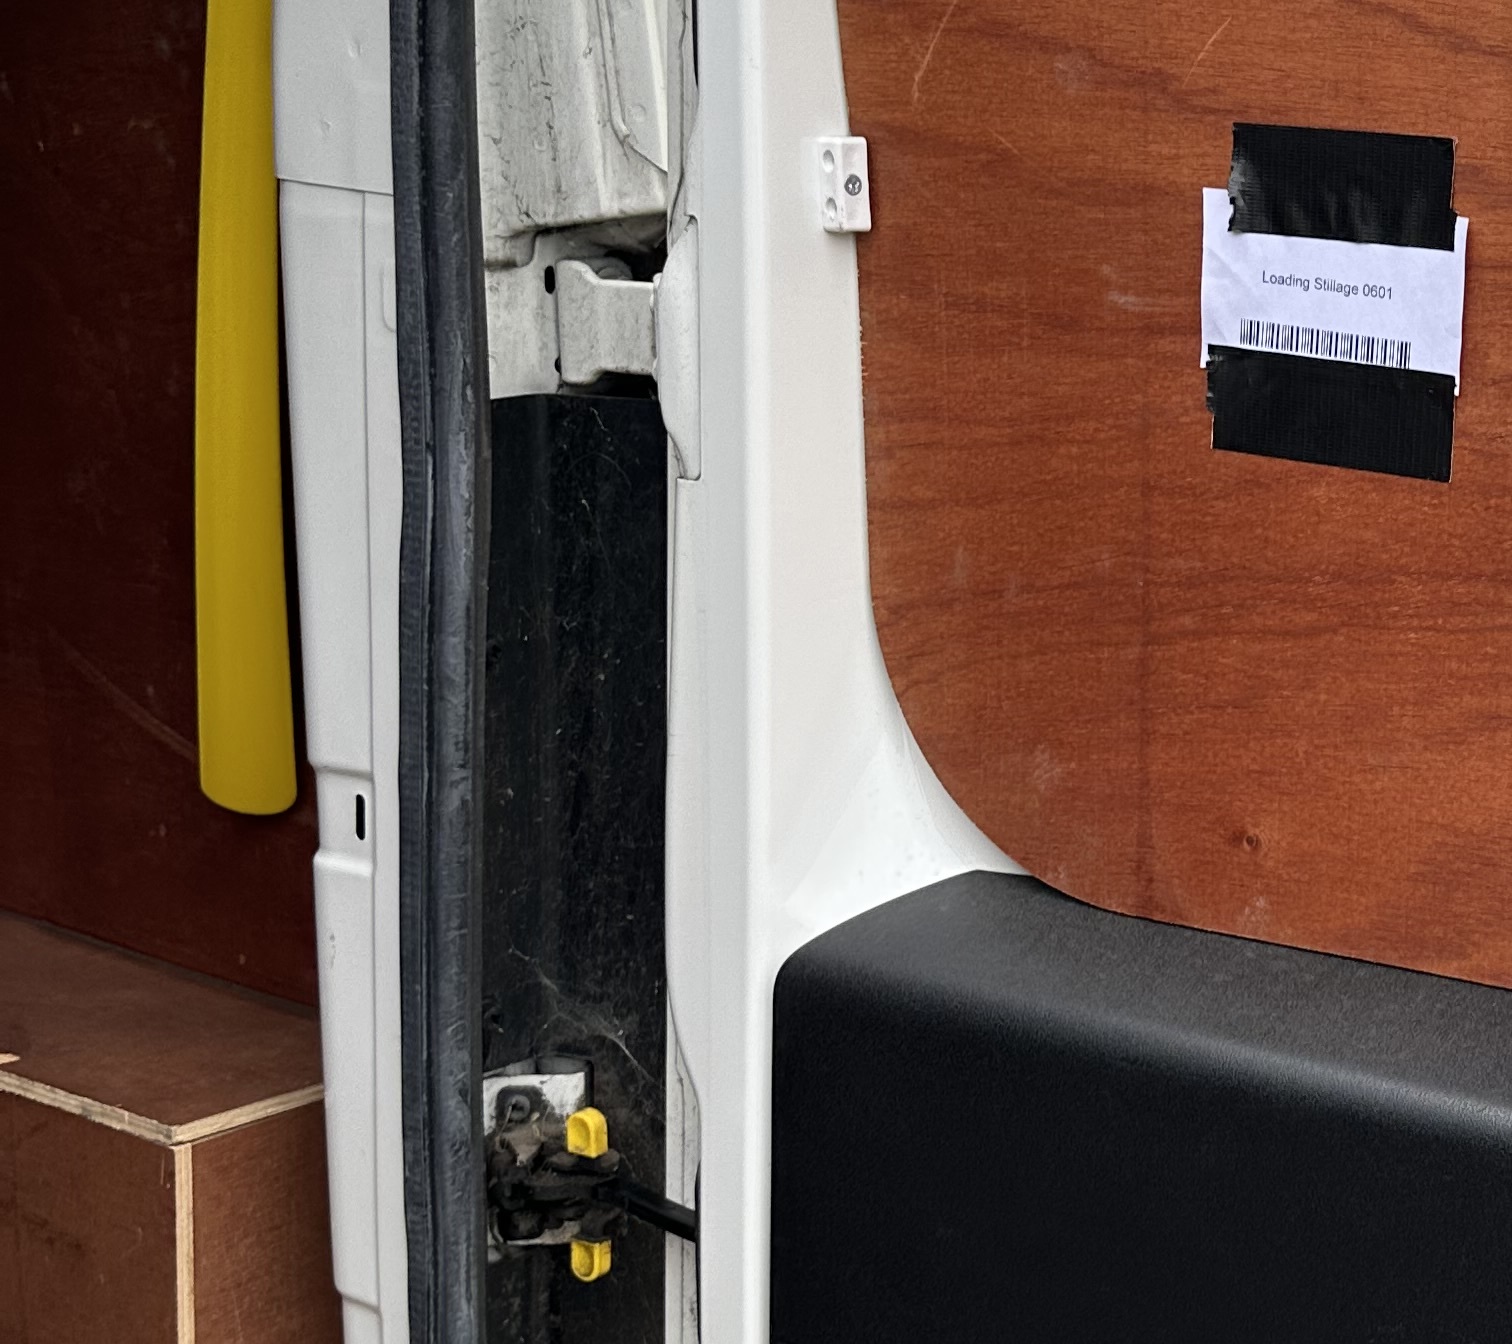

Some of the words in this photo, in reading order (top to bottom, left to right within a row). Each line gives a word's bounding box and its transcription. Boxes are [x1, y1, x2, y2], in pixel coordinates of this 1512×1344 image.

[1262, 270, 1310, 292] Loading
[1314, 277, 1359, 297] Stillage
[1362, 283, 1392, 300] 0601
